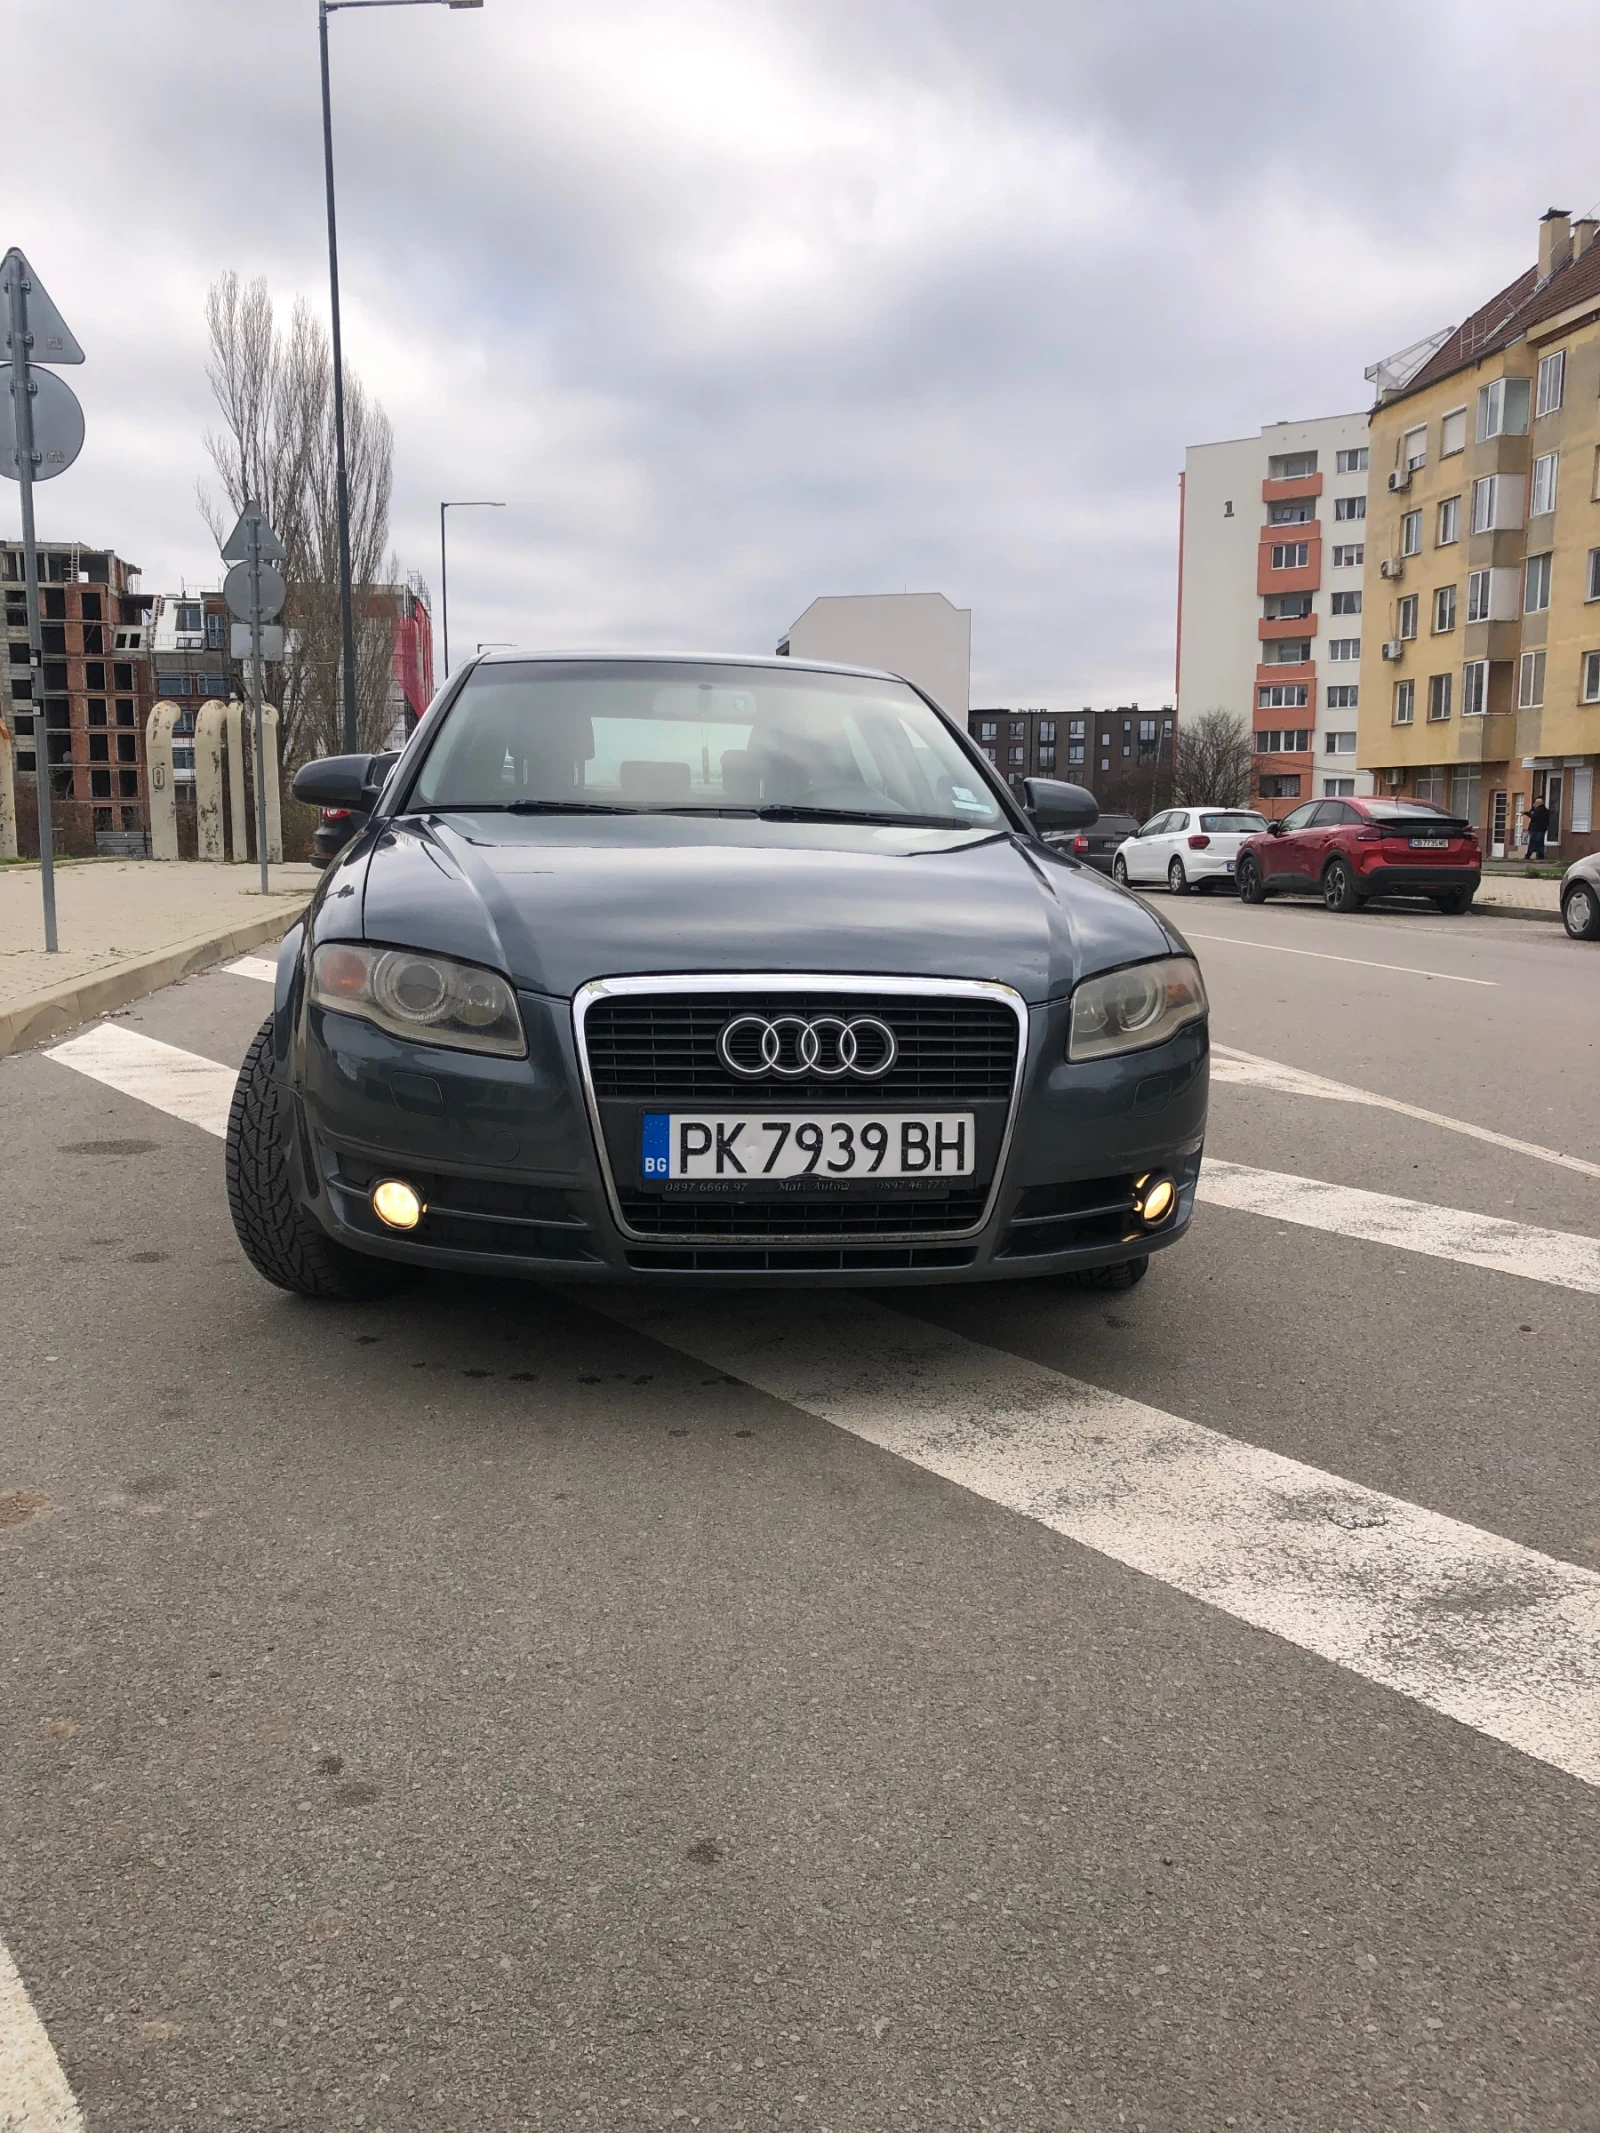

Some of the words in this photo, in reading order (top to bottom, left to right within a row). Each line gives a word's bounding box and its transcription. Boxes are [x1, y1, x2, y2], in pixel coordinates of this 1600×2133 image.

[1224, 501, 1235, 518] 1
[680, 1122, 747, 1174] PK
[762, 1122, 888, 1173] 7939
[901, 1122, 965, 1172] BH
[645, 1158, 667, 1173] BG
[665, 1182, 695, 1192] 0897
[699, 1182, 729, 1192] 6666
[733, 1182, 748, 1192] 97
[876, 1180, 905, 1190] 0897
[909, 1180, 923, 1189] 46
